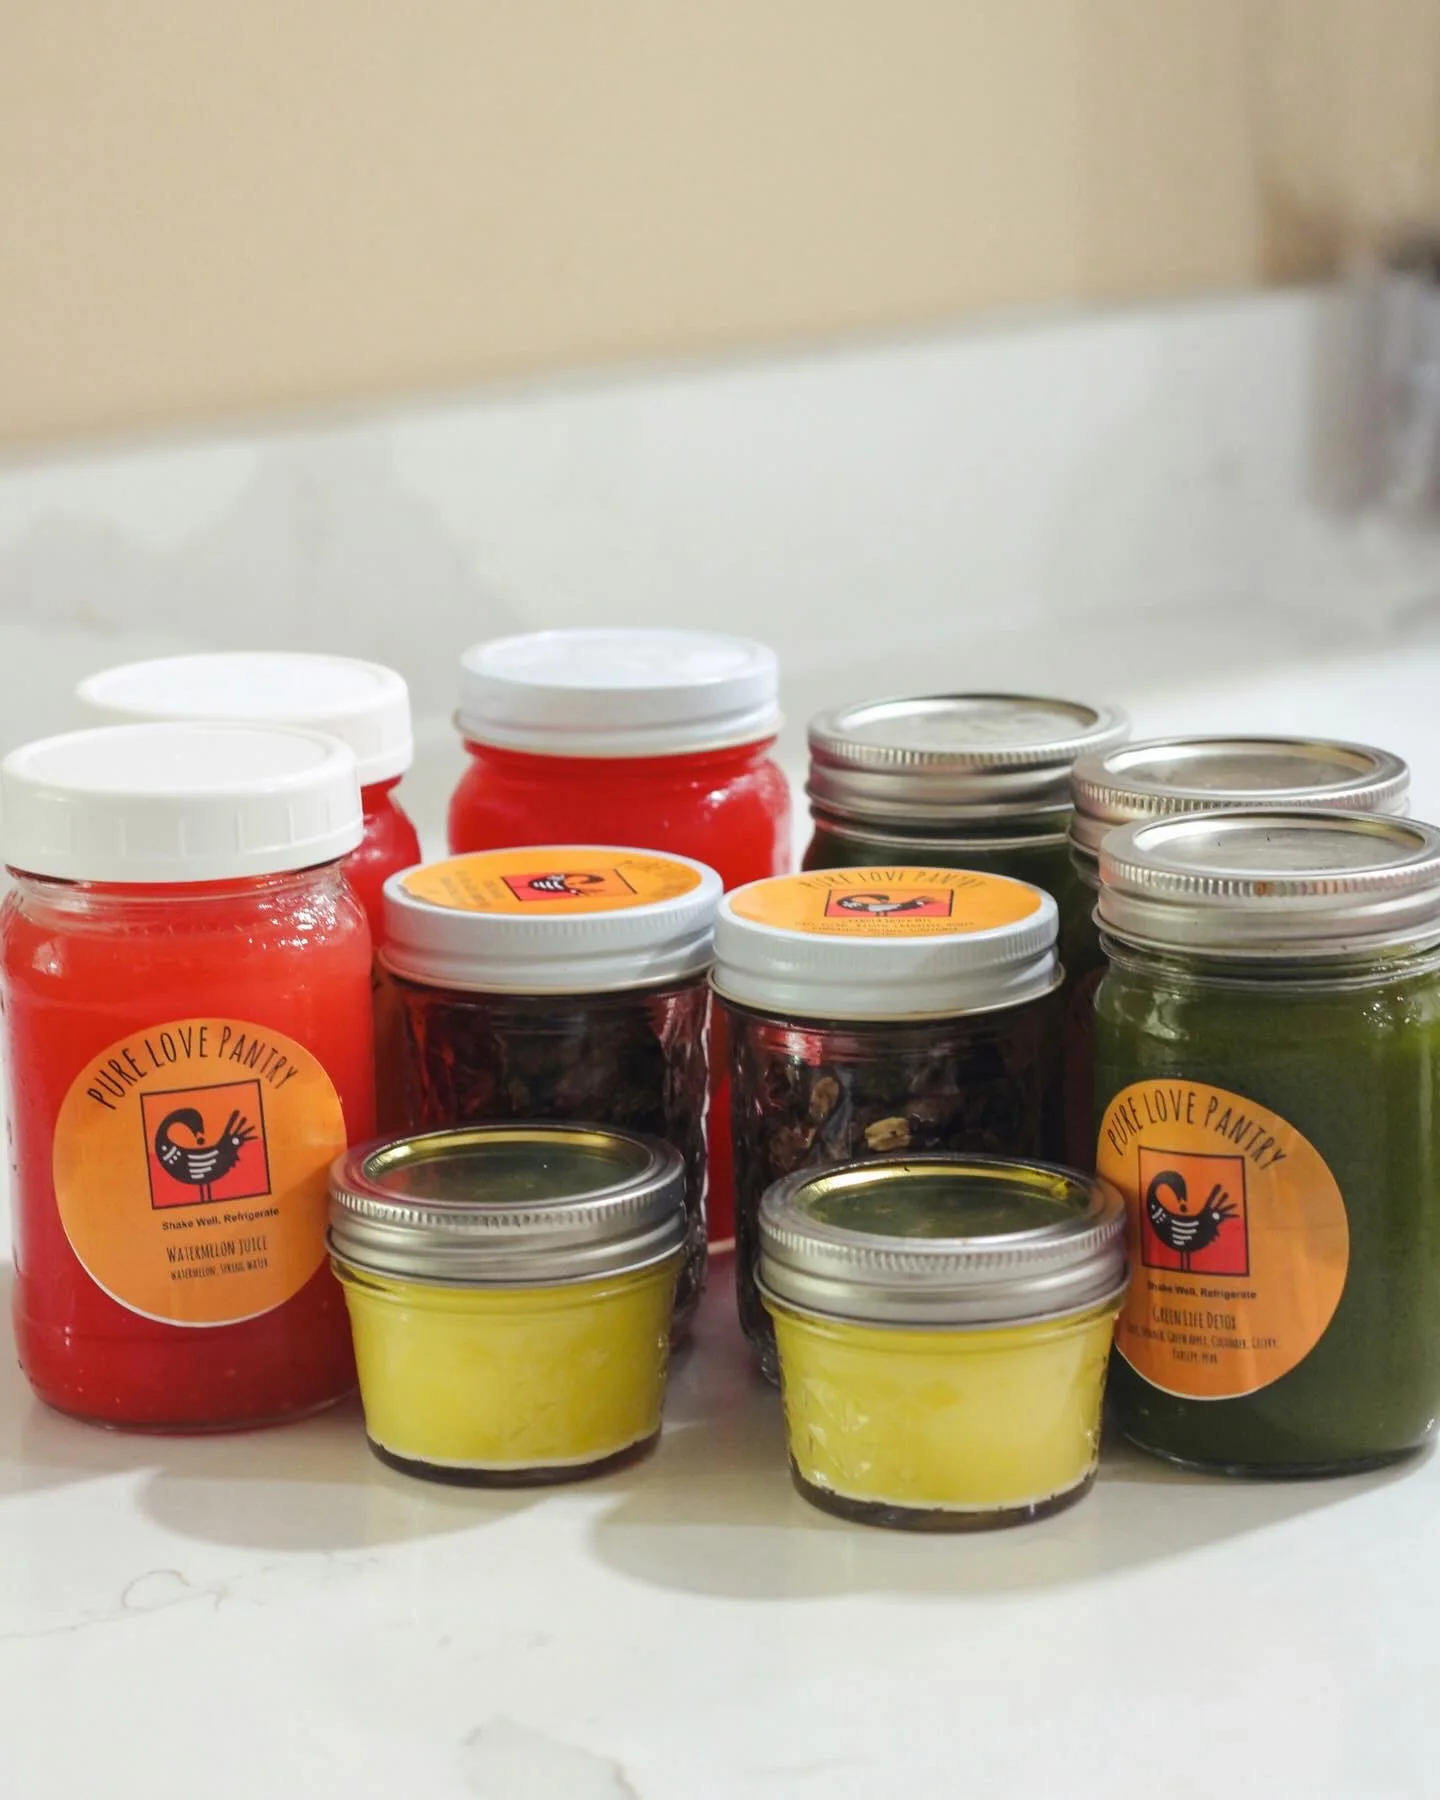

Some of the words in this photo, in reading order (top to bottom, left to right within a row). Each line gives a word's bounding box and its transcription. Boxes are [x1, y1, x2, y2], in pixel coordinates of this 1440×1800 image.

[87, 1048, 147, 1110] PURE
[144, 1026, 209, 1068] LOVE
[218, 1025, 298, 1089] PANTRY
[1107, 1096, 1143, 1156] PURE
[1143, 1087, 1196, 1125] LOVE
[1204, 1095, 1287, 1170] PANTRY
[161, 1219, 194, 1231] Shake
[223, 1207, 280, 1223] Refrigerate
[1200, 1287, 1258, 1301] Refrigerate
